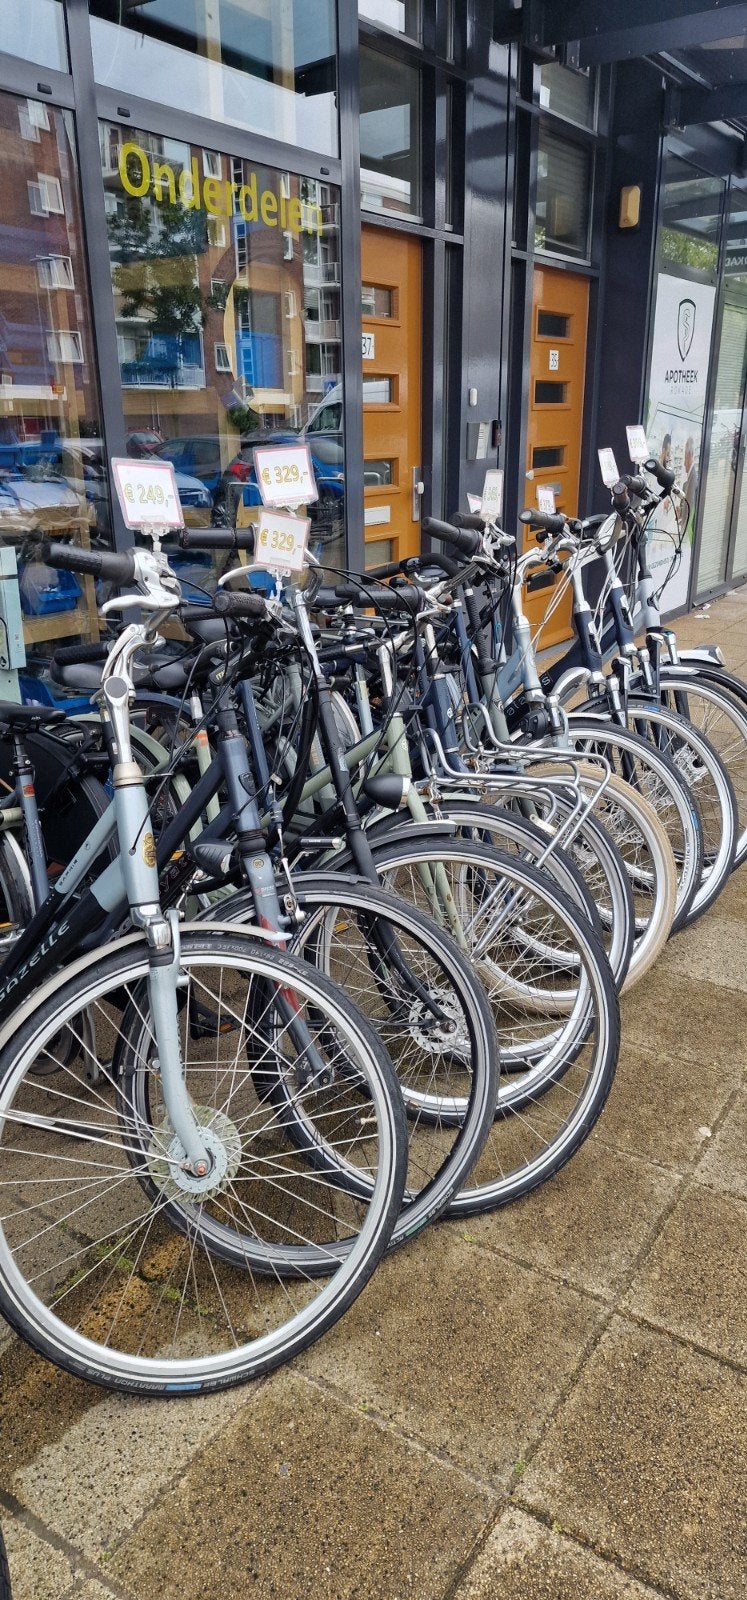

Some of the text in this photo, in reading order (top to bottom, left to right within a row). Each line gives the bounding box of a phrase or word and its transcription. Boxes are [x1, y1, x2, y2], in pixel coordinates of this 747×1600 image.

[118, 141, 323, 237] Onderdelen
[664, 369, 698, 383] APOTHEEK
[262, 464, 308, 485] € 329,-
[125, 483, 174, 508] € 249,-
[260, 528, 302, 555] € 329,-
[86, 1368, 112, 1382] PLUS
[114, 1377, 165, 1391] MARATHON
[202, 1369, 256, 1388] SCHWALBE
